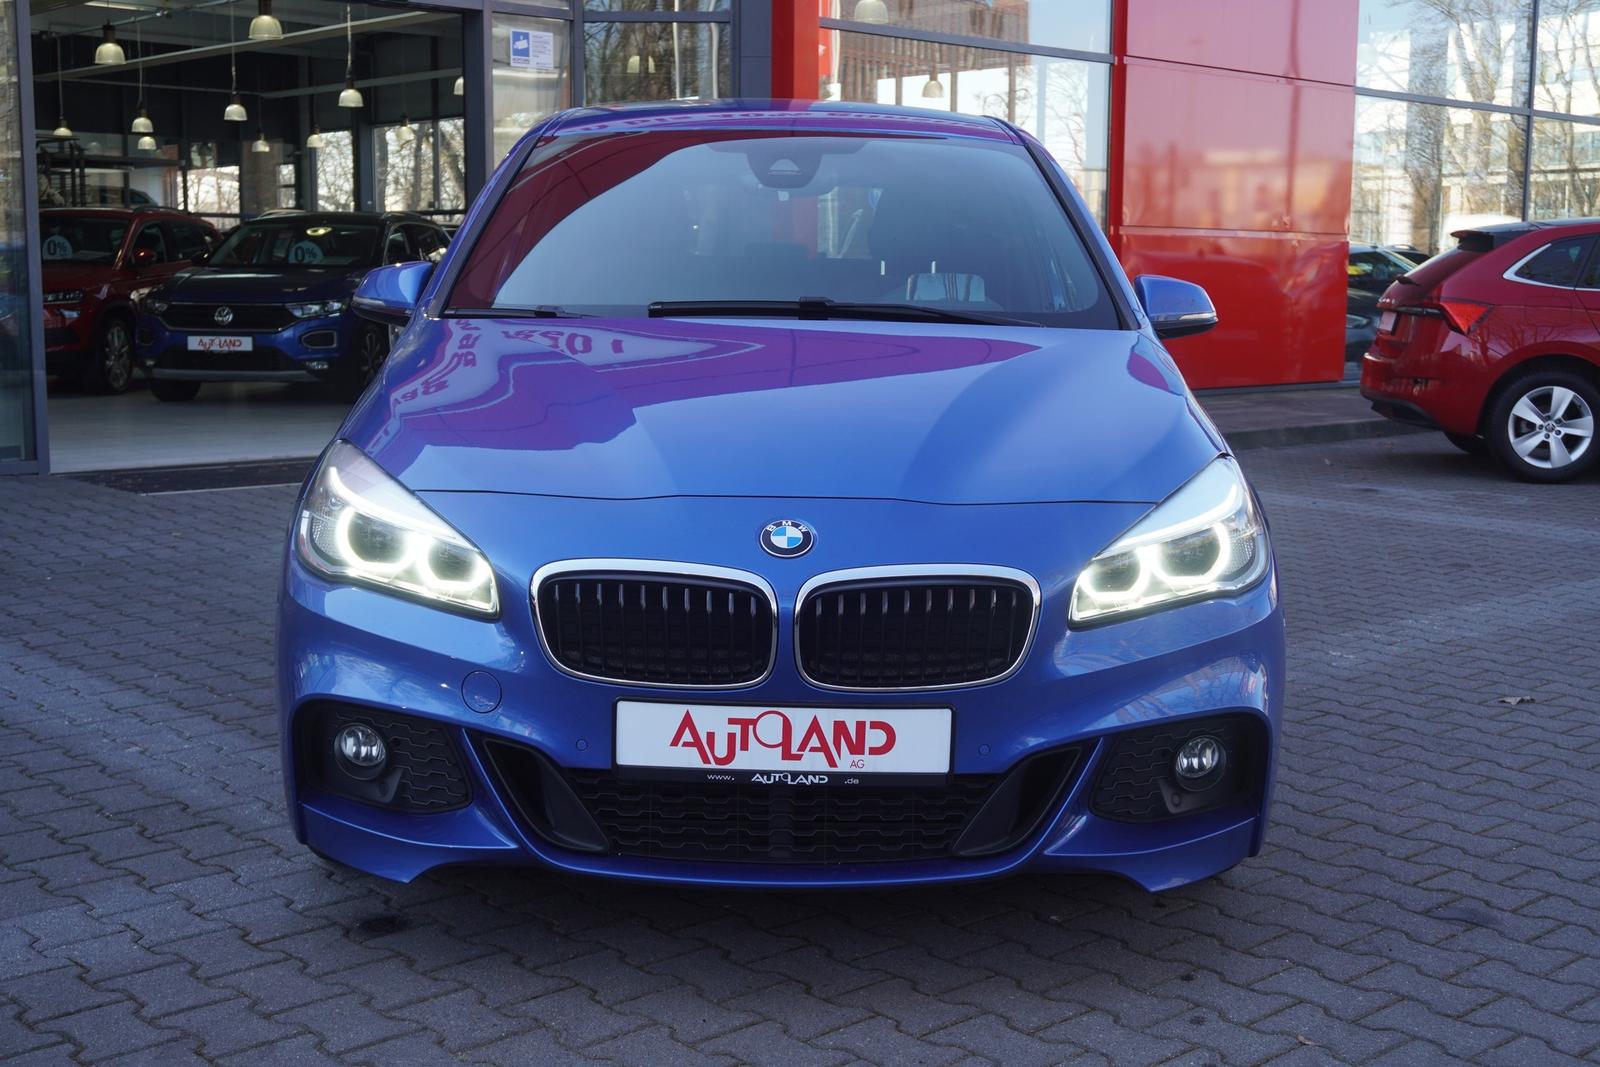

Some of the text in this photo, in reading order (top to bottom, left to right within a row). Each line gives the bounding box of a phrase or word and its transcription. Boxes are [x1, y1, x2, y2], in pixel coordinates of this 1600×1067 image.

[294, 246, 317, 262] 0%
[767, 520, 809, 532] BMW
[669, 709, 897, 769] AUTOLAND
[849, 759, 865, 769] AG
[751, 772, 829, 785] AUTOLAND
[844, 777, 859, 785] .de
